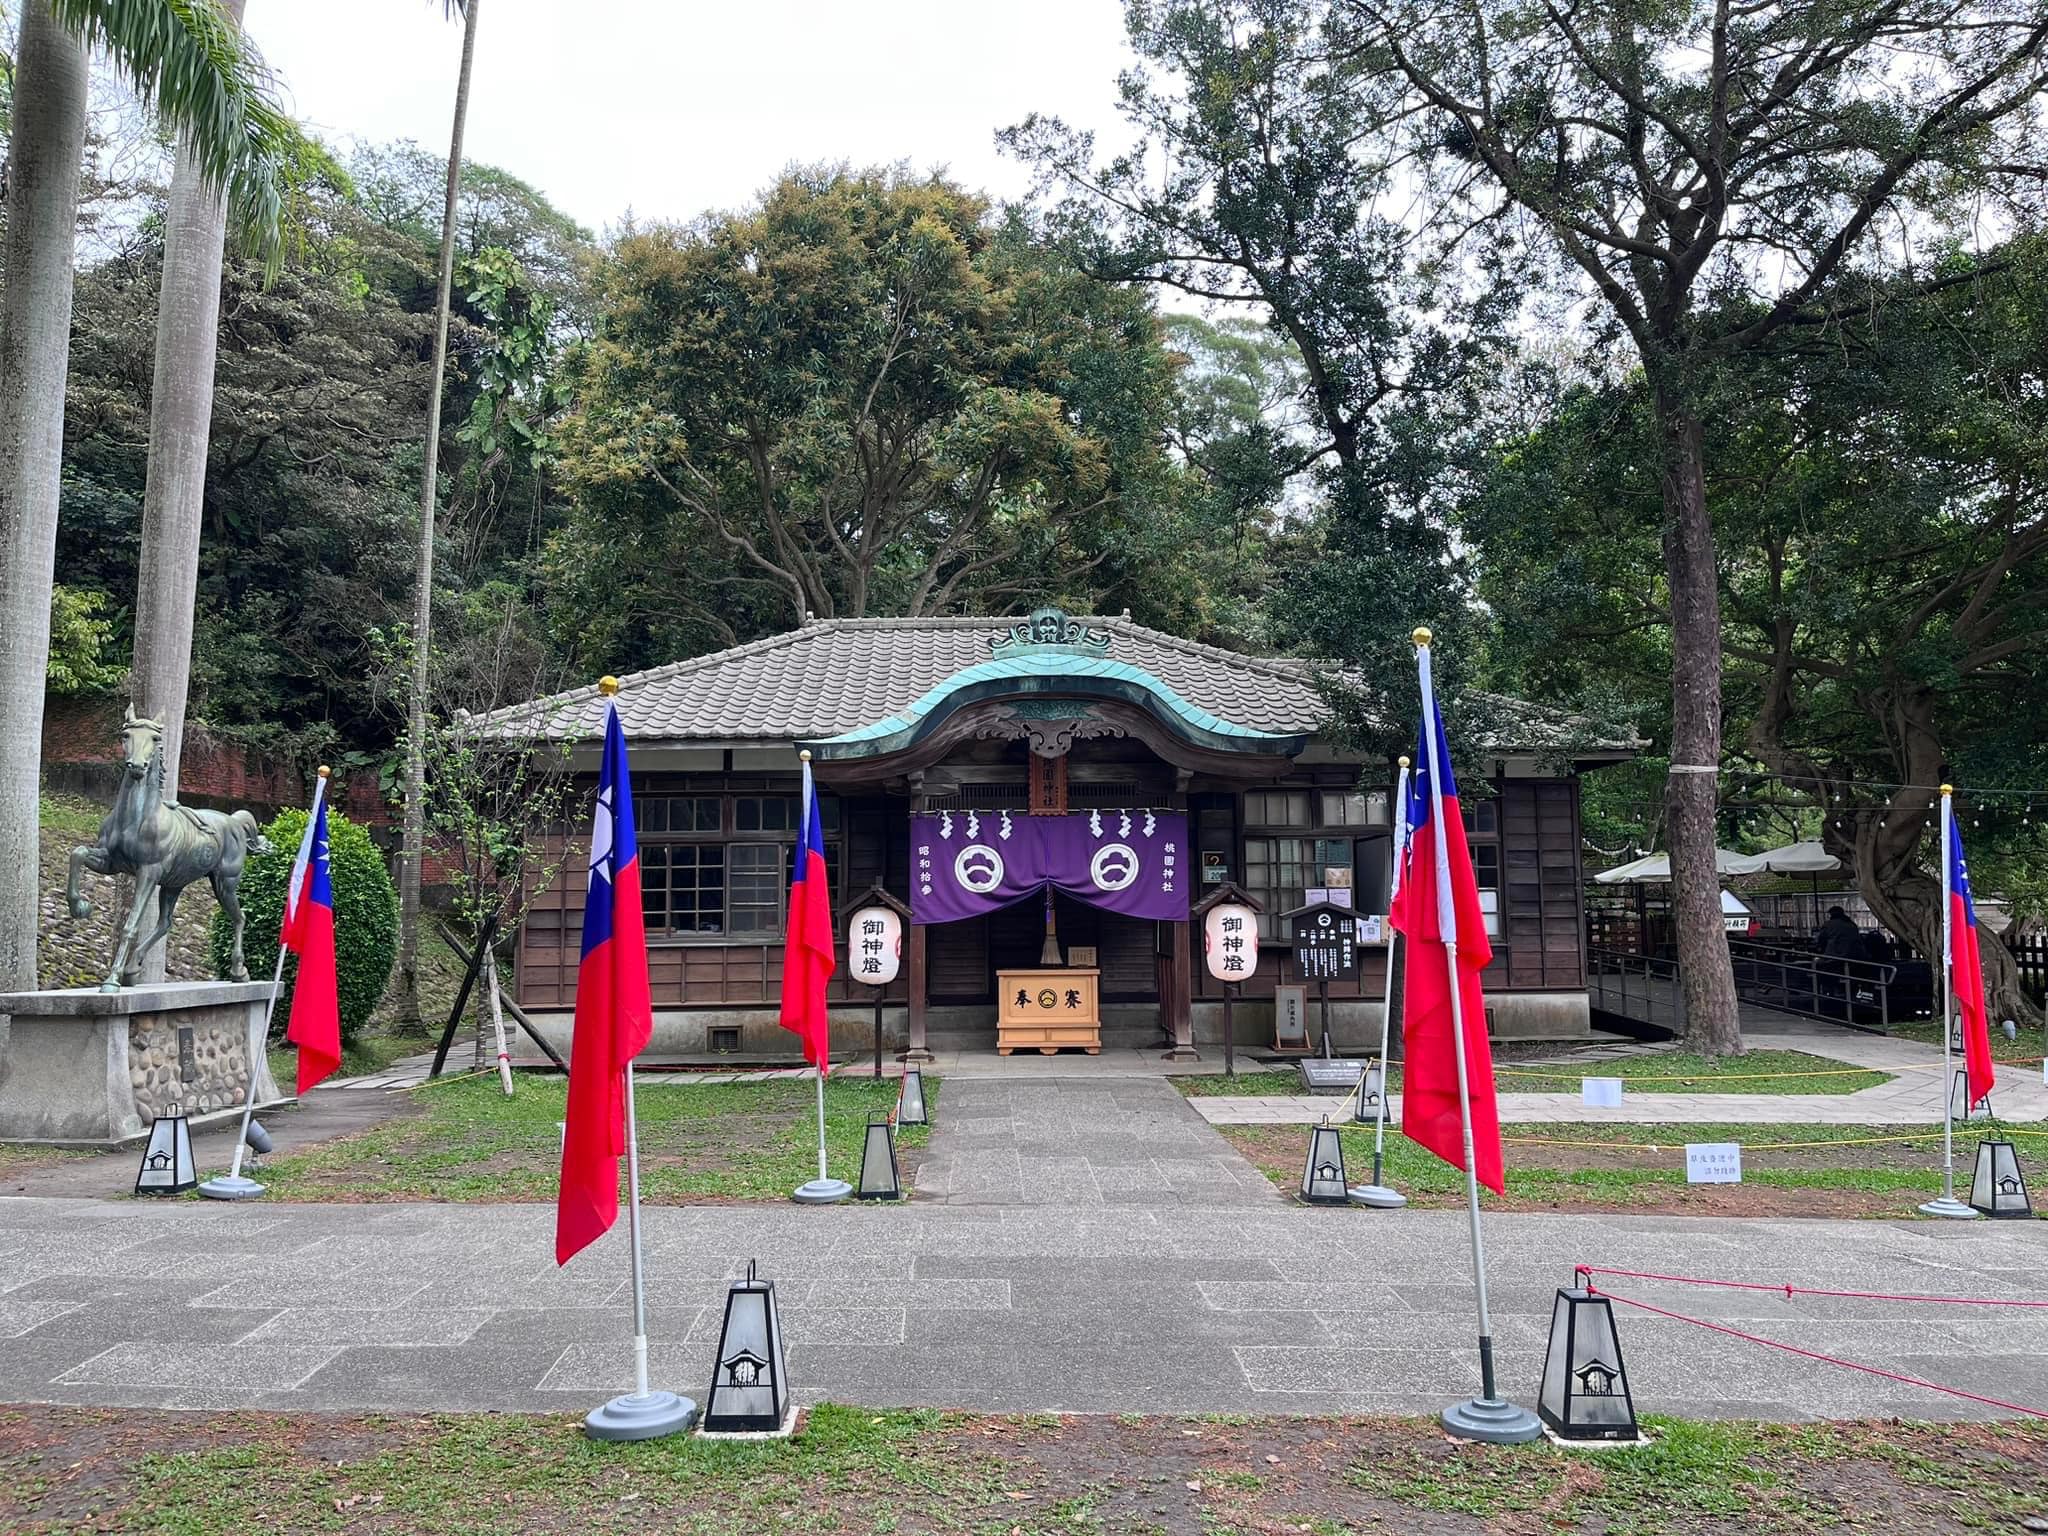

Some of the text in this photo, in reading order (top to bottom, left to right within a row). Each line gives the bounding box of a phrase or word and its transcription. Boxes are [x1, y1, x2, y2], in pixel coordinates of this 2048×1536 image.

[1161, 842, 1175, 892] 桃園神社
[861, 919, 885, 974] 御神燈
[1221, 915, 1245, 972] 御神燈
